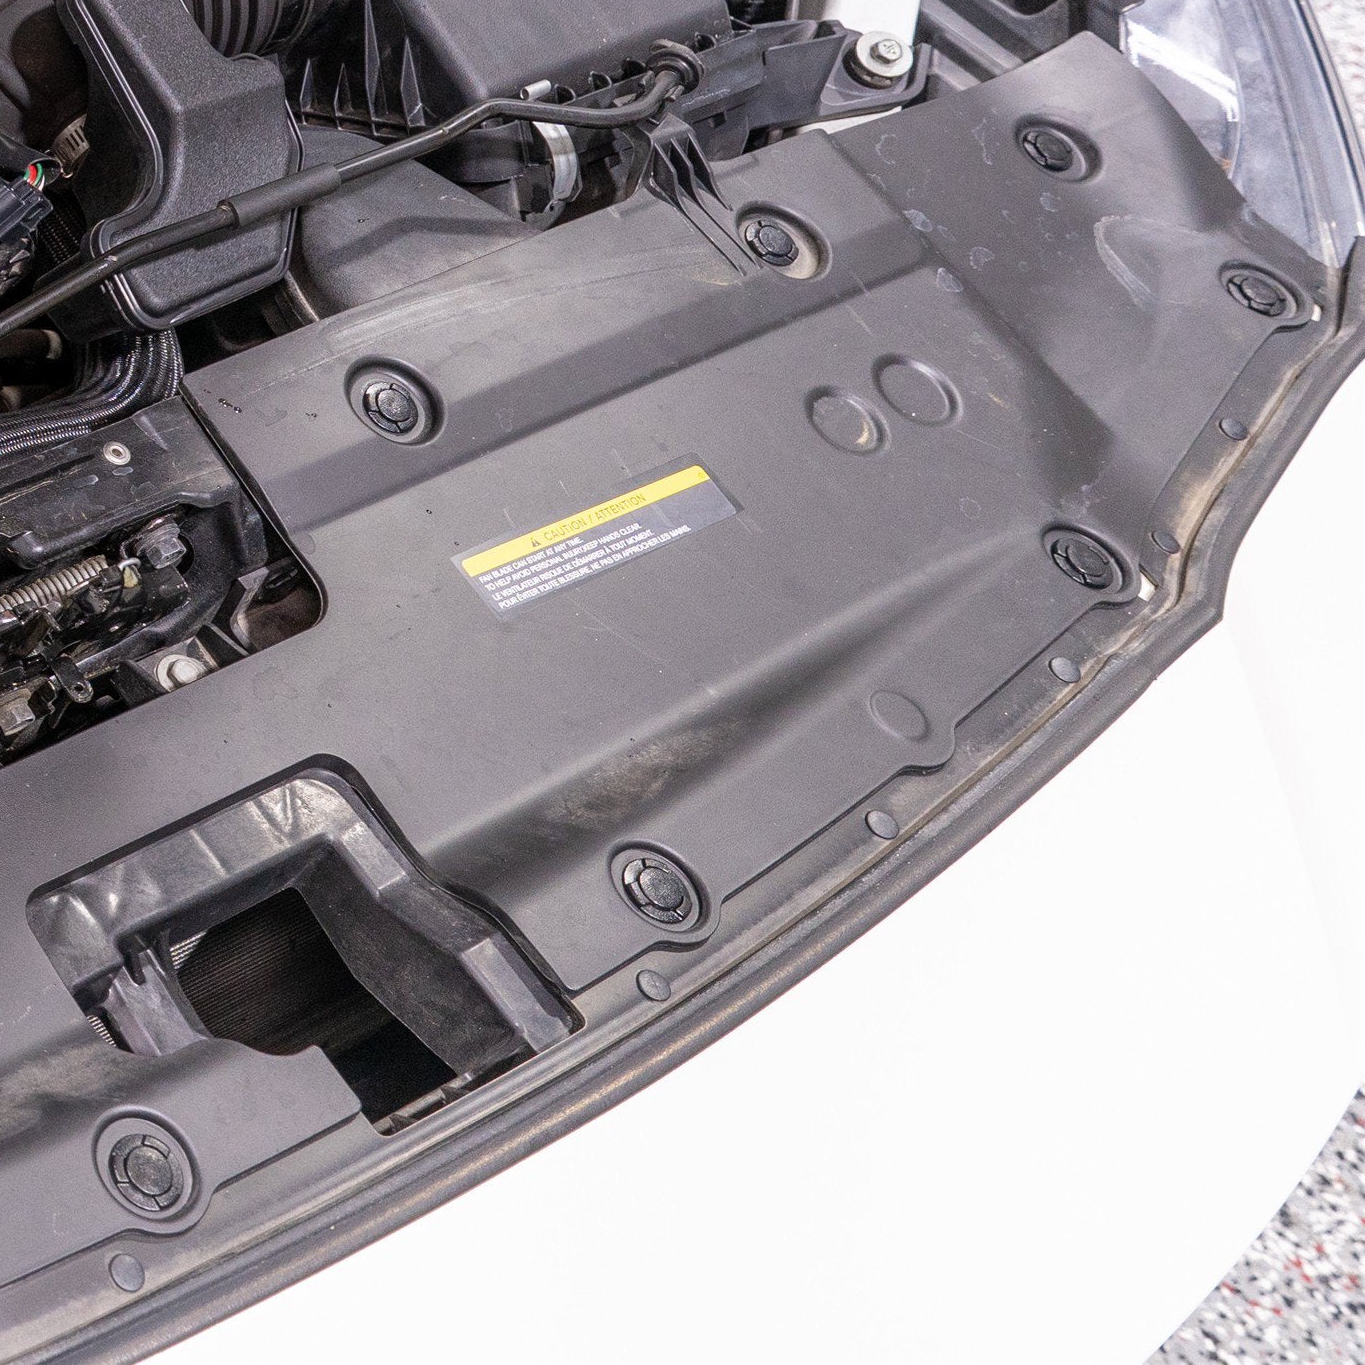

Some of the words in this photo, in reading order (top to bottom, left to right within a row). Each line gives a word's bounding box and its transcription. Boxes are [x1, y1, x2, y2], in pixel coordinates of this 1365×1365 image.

[543, 518, 587, 541] CAUTION
[594, 493, 646, 520] ATTENTION
[478, 573, 493, 583] FAN
[491, 565, 514, 578] BLADE
[512, 559, 528, 569] CAN
[525, 551, 546, 564] START
[545, 548, 554, 556] AT
[553, 542, 569, 552] ANY
[484, 582, 496, 591] TO
[494, 576, 513, 587] HELP
[511, 568, 531, 580] AVOID
[530, 554, 564, 573] PERSONAL
[597, 531, 621, 545] HANDS
[491, 592, 502, 601] LE
[499, 576, 542, 597] VENTILATEUR
[538, 567, 564, 581] RISQUE
[562, 563, 573, 572] DE
[609, 540, 627, 552] TOUT
[498, 596, 519, 609] POUR
[536, 579, 560, 593] TOUTE
[590, 561, 602, 570] NE
[599, 556, 614, 567] PAS
[611, 553, 623, 562] EN
[621, 538, 660, 558] APPROCHER
[657, 533, 671, 542] LES
